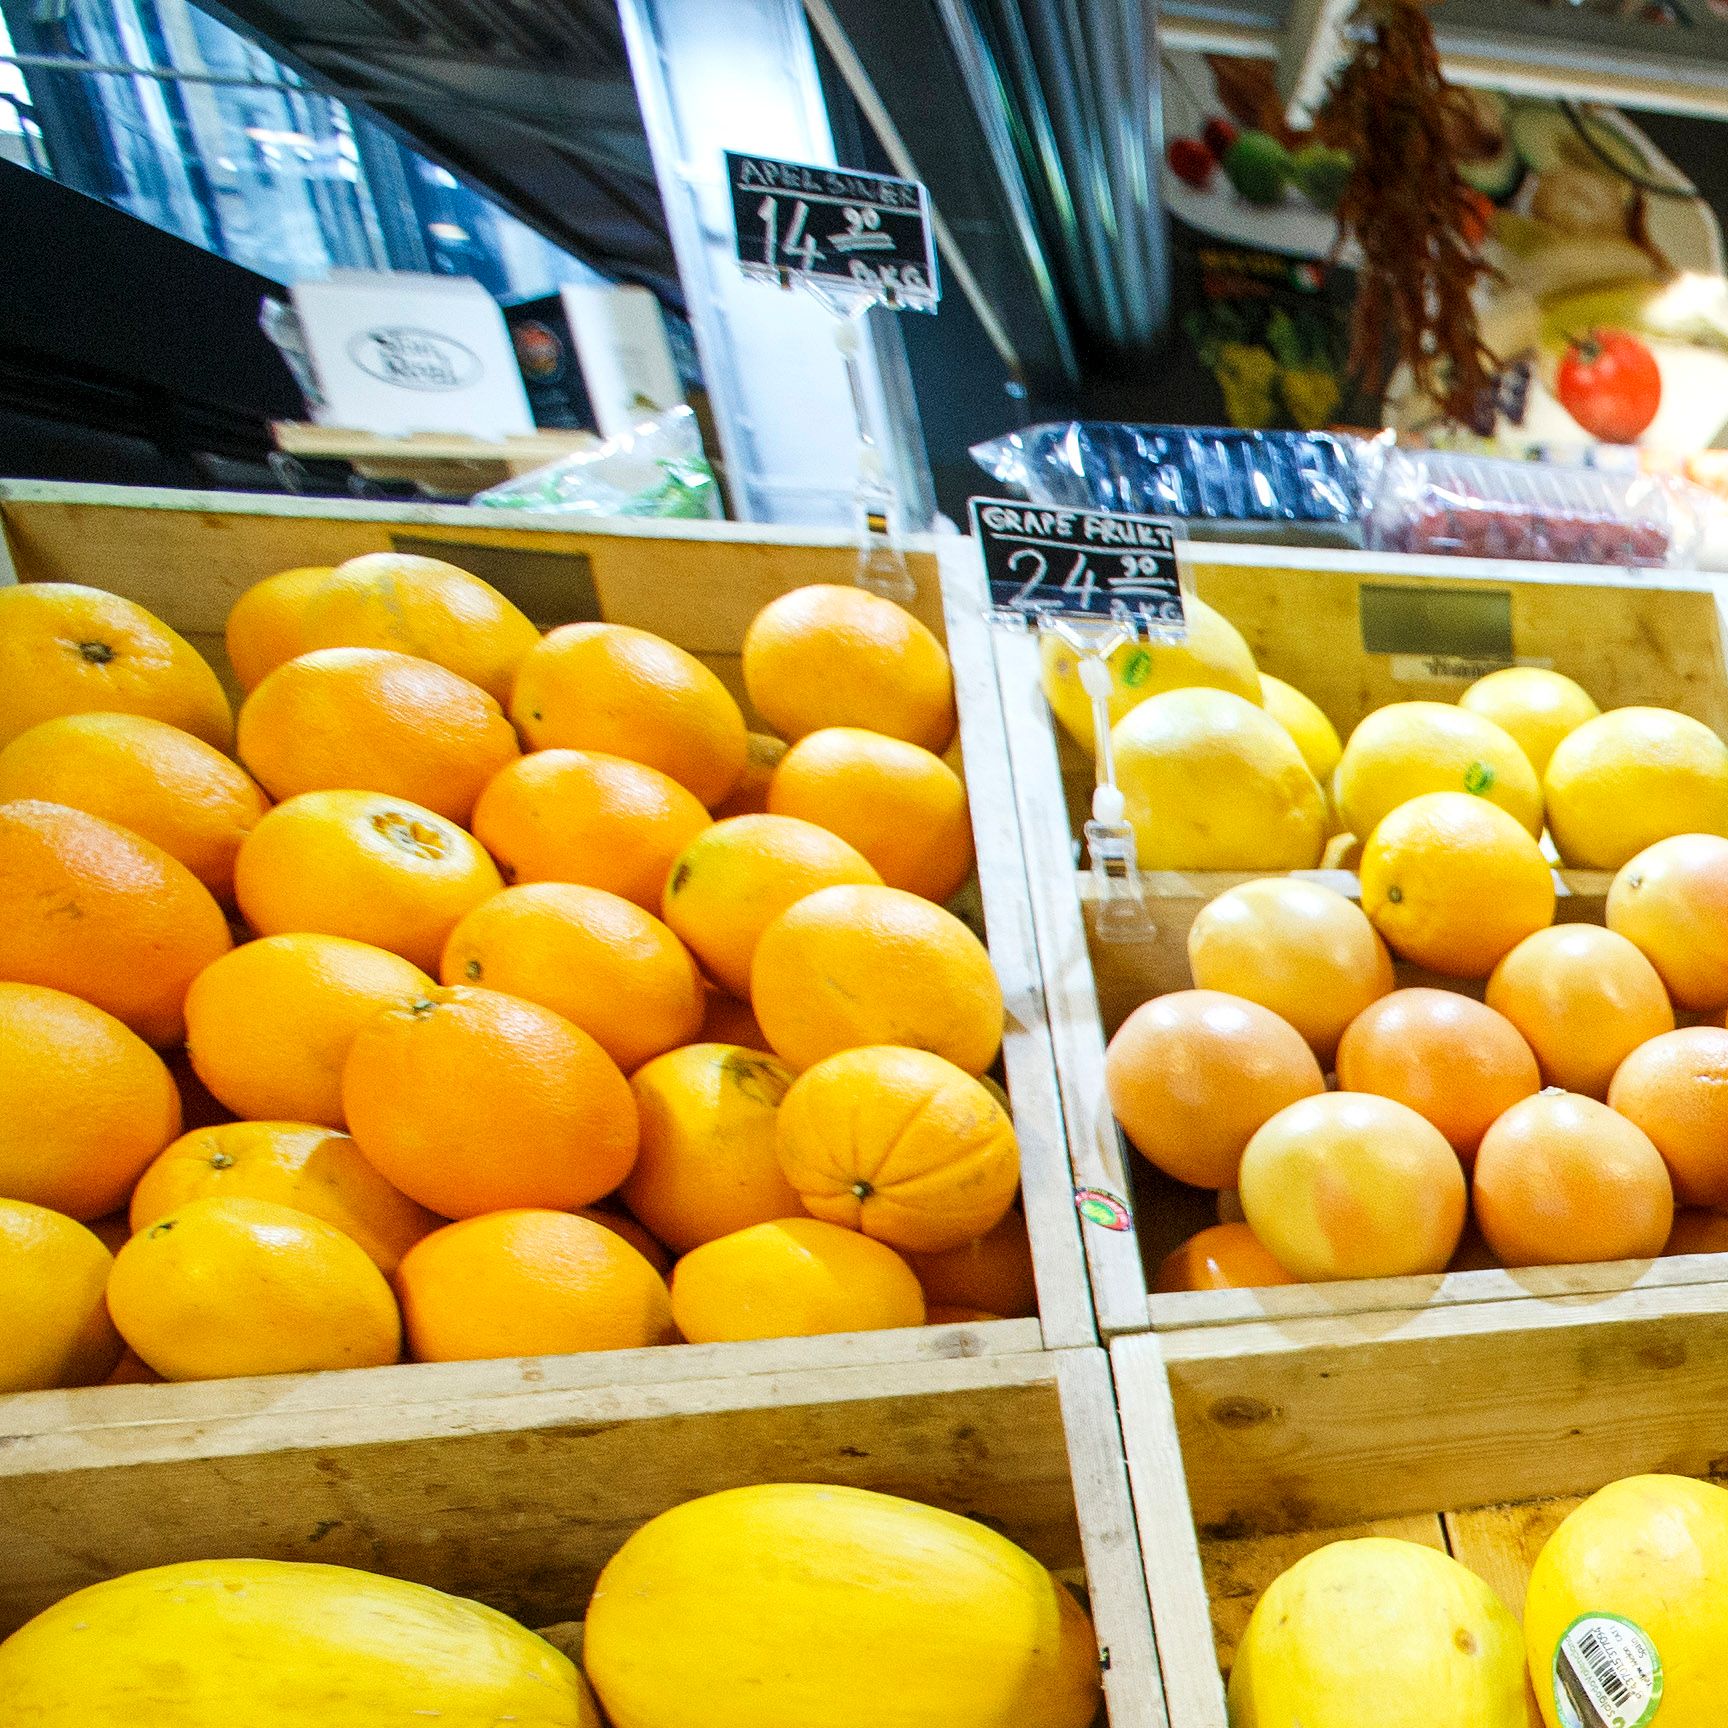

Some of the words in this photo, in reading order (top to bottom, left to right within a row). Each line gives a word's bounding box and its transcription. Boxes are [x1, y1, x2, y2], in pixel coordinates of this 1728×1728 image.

[757, 194, 827, 270] 14
[981, 506, 1077, 538] GRAPE
[1084, 515, 1173, 550] FRUKT
[1008, 548, 1101, 610] 24
[1120, 554, 1160, 577] 90
[1628, 1636, 1647, 1659] Spain
